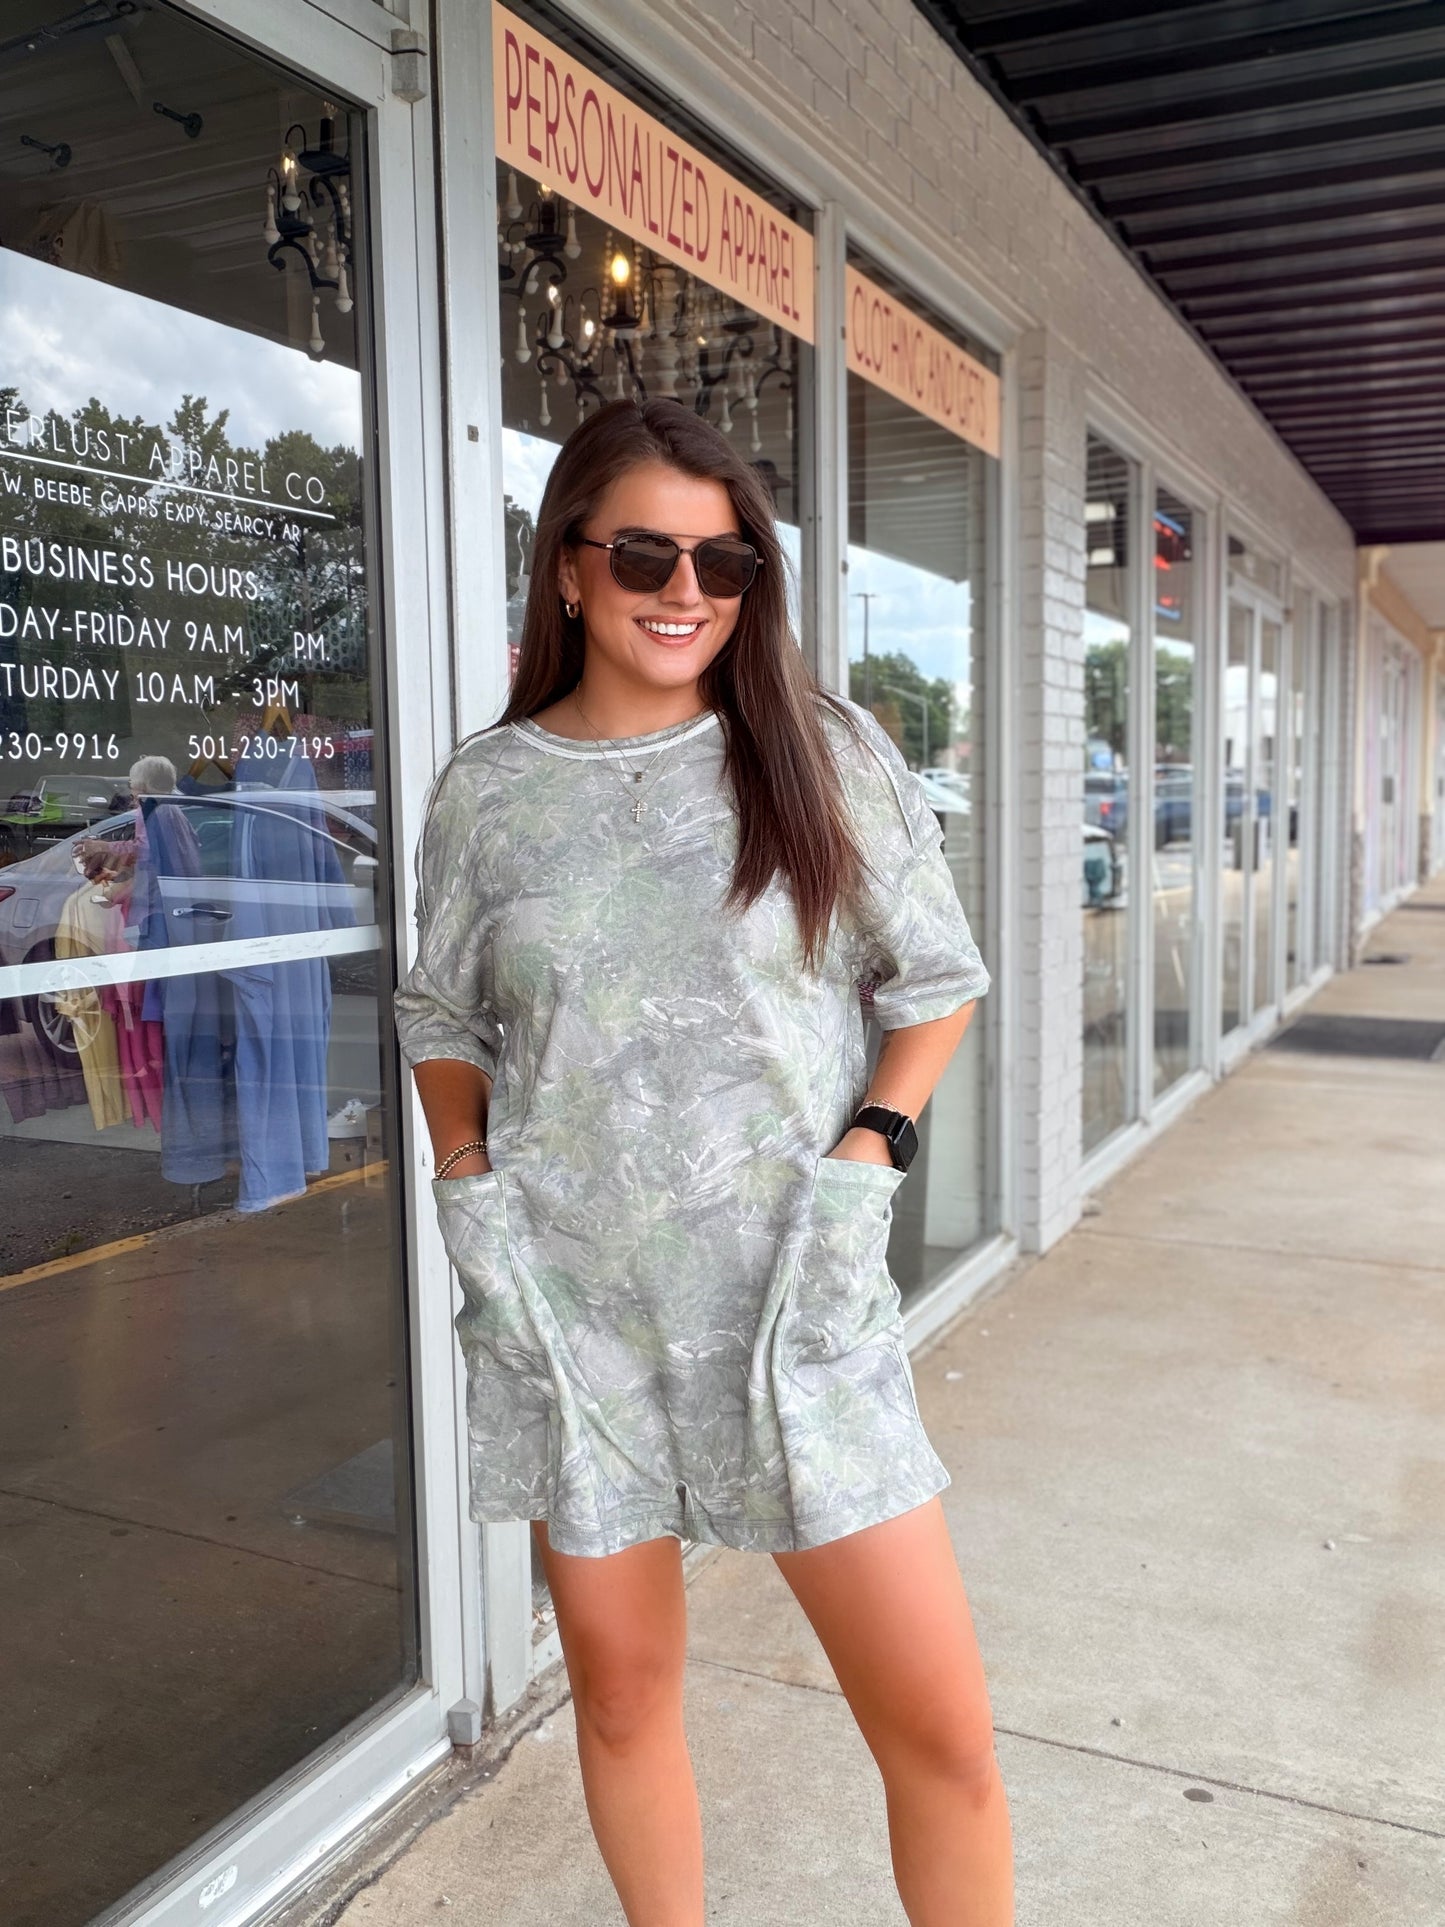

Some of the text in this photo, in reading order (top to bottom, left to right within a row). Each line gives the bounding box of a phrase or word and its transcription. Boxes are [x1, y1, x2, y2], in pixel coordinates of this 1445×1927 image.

[505, 28, 800, 321] PERSONALIZED APPAREL
[6, 409, 332, 507] ERLUST APPAREL CO.
[2, 472, 26, 496] W.
[34, 477, 92, 507] BEEBE
[101, 490, 158, 518] CAPPS
[215, 510, 276, 540] SEARCY,
[282, 523, 300, 543] AR
[2, 537, 264, 601] BUSINESS HOURS:
[0, 603, 171, 649] DAY-FRIDAY
[0, 732, 335, 760] 30-9916 501-230-7195
